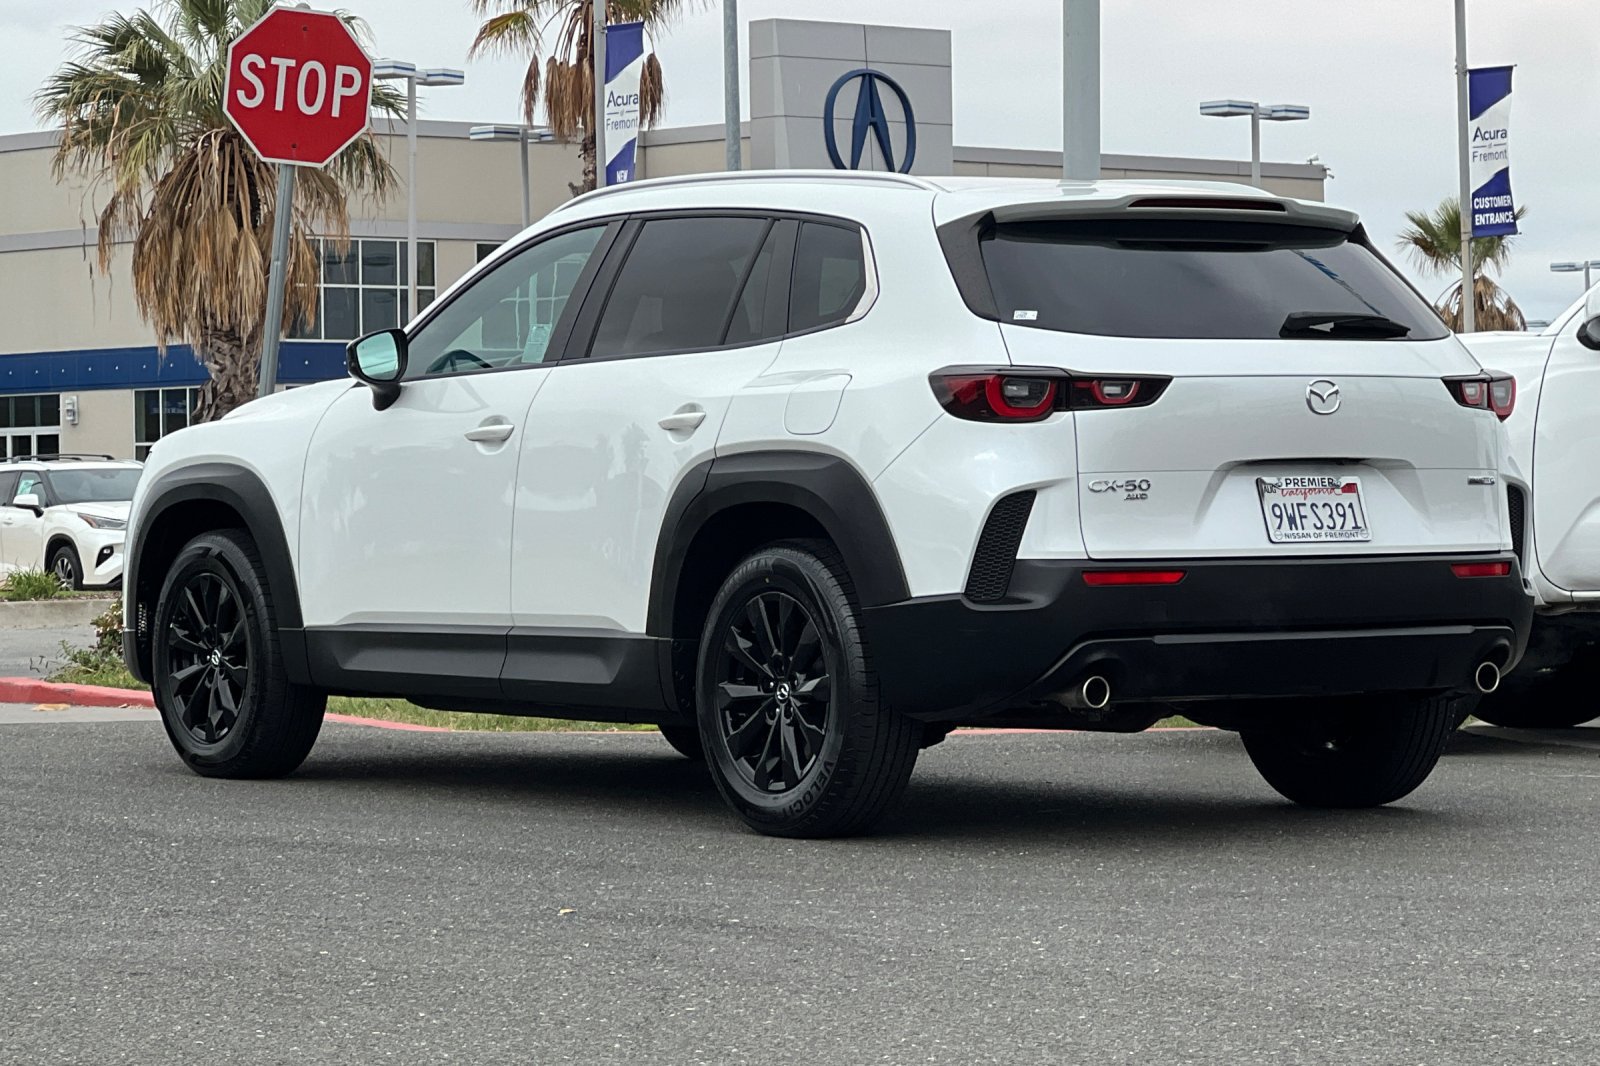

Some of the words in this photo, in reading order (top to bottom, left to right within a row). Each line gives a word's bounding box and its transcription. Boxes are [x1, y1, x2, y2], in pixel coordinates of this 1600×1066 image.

[236, 53, 362, 118] STOP
[607, 91, 638, 108] Acura
[606, 117, 638, 131] Fremont
[1473, 126, 1507, 142] Acura
[1472, 149, 1508, 162] Fremont
[617, 169, 628, 183] NEW
[1474, 195, 1512, 209] CUSTOMER
[1475, 212, 1514, 226] ENTRANCE
[1088, 479, 1151, 493] CX-50
[1285, 477, 1334, 488] PREMIER
[1124, 493, 1149, 501] AWD
[1271, 502, 1362, 531] 9WFS391
